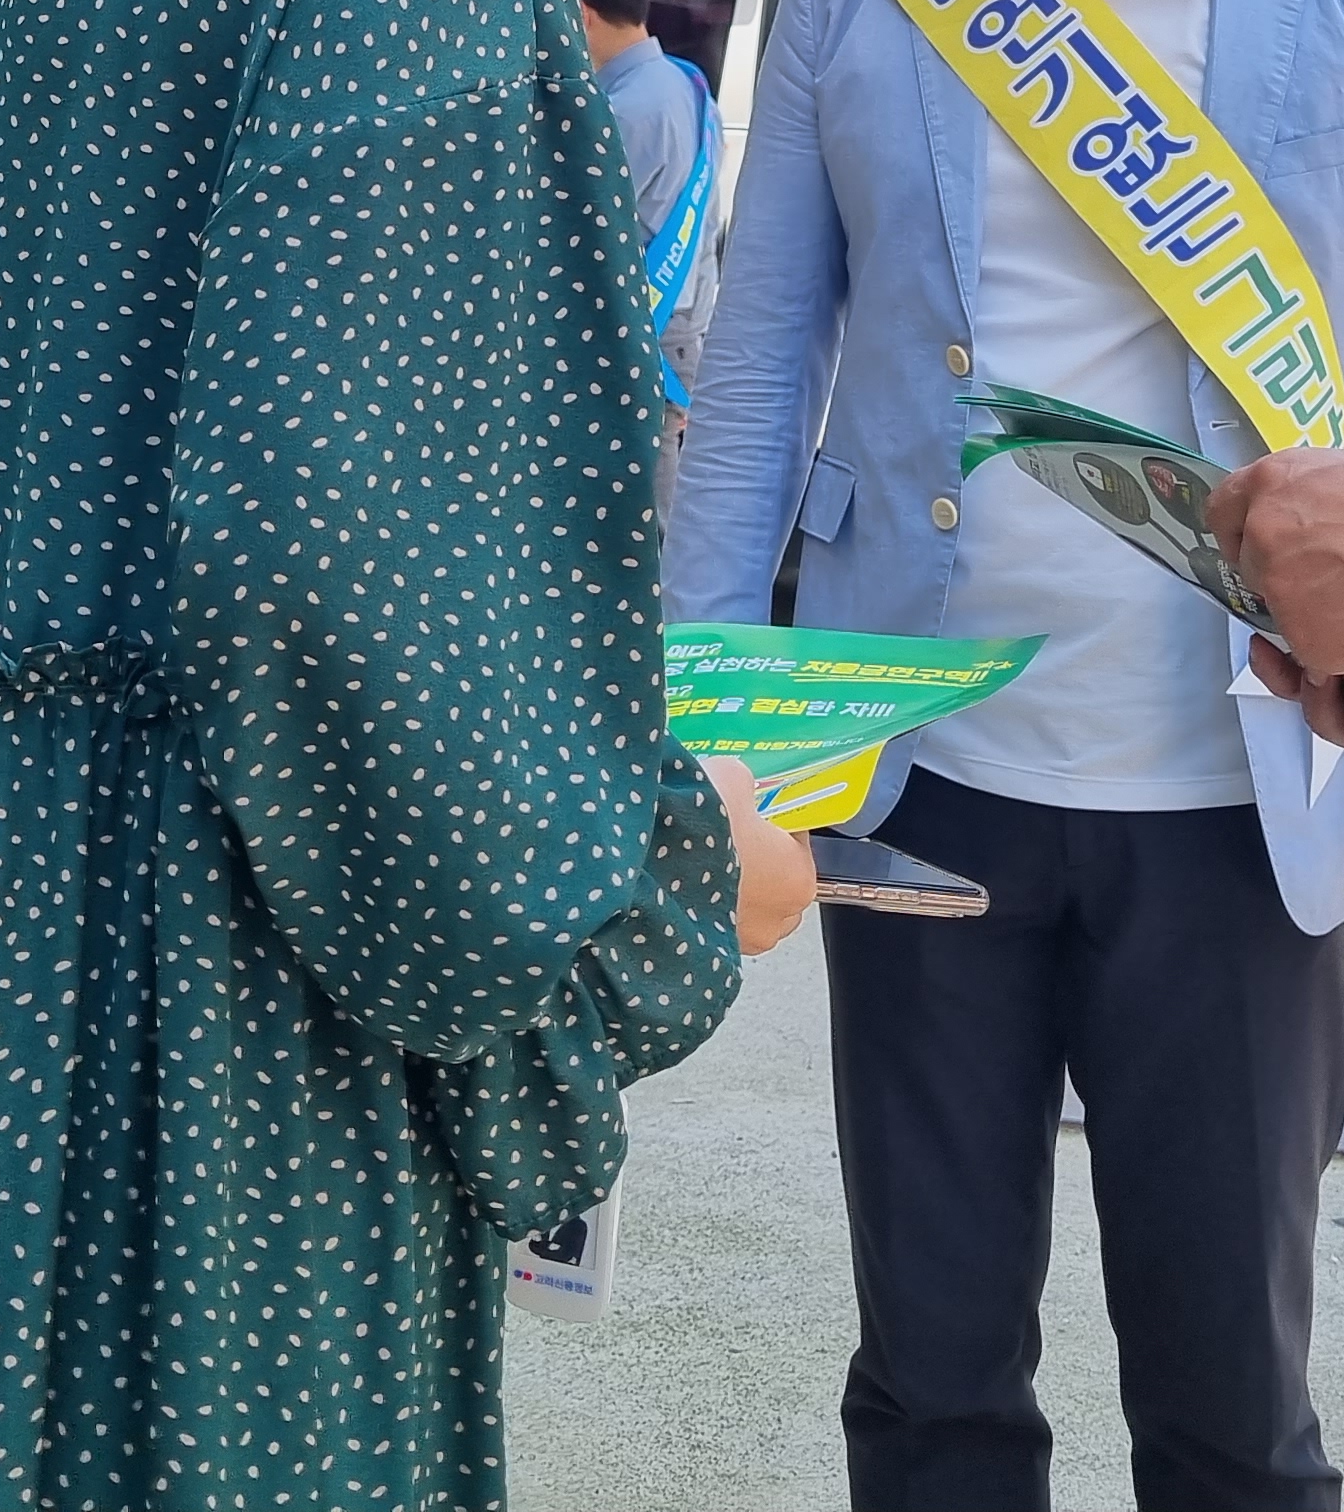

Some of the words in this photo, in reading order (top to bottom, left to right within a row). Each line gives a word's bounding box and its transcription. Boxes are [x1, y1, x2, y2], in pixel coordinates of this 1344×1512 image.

[1067, 93, 1246, 267] 없는
[692, 656, 798, 675] 실천하는
[749, 697, 836, 718] 결심한
